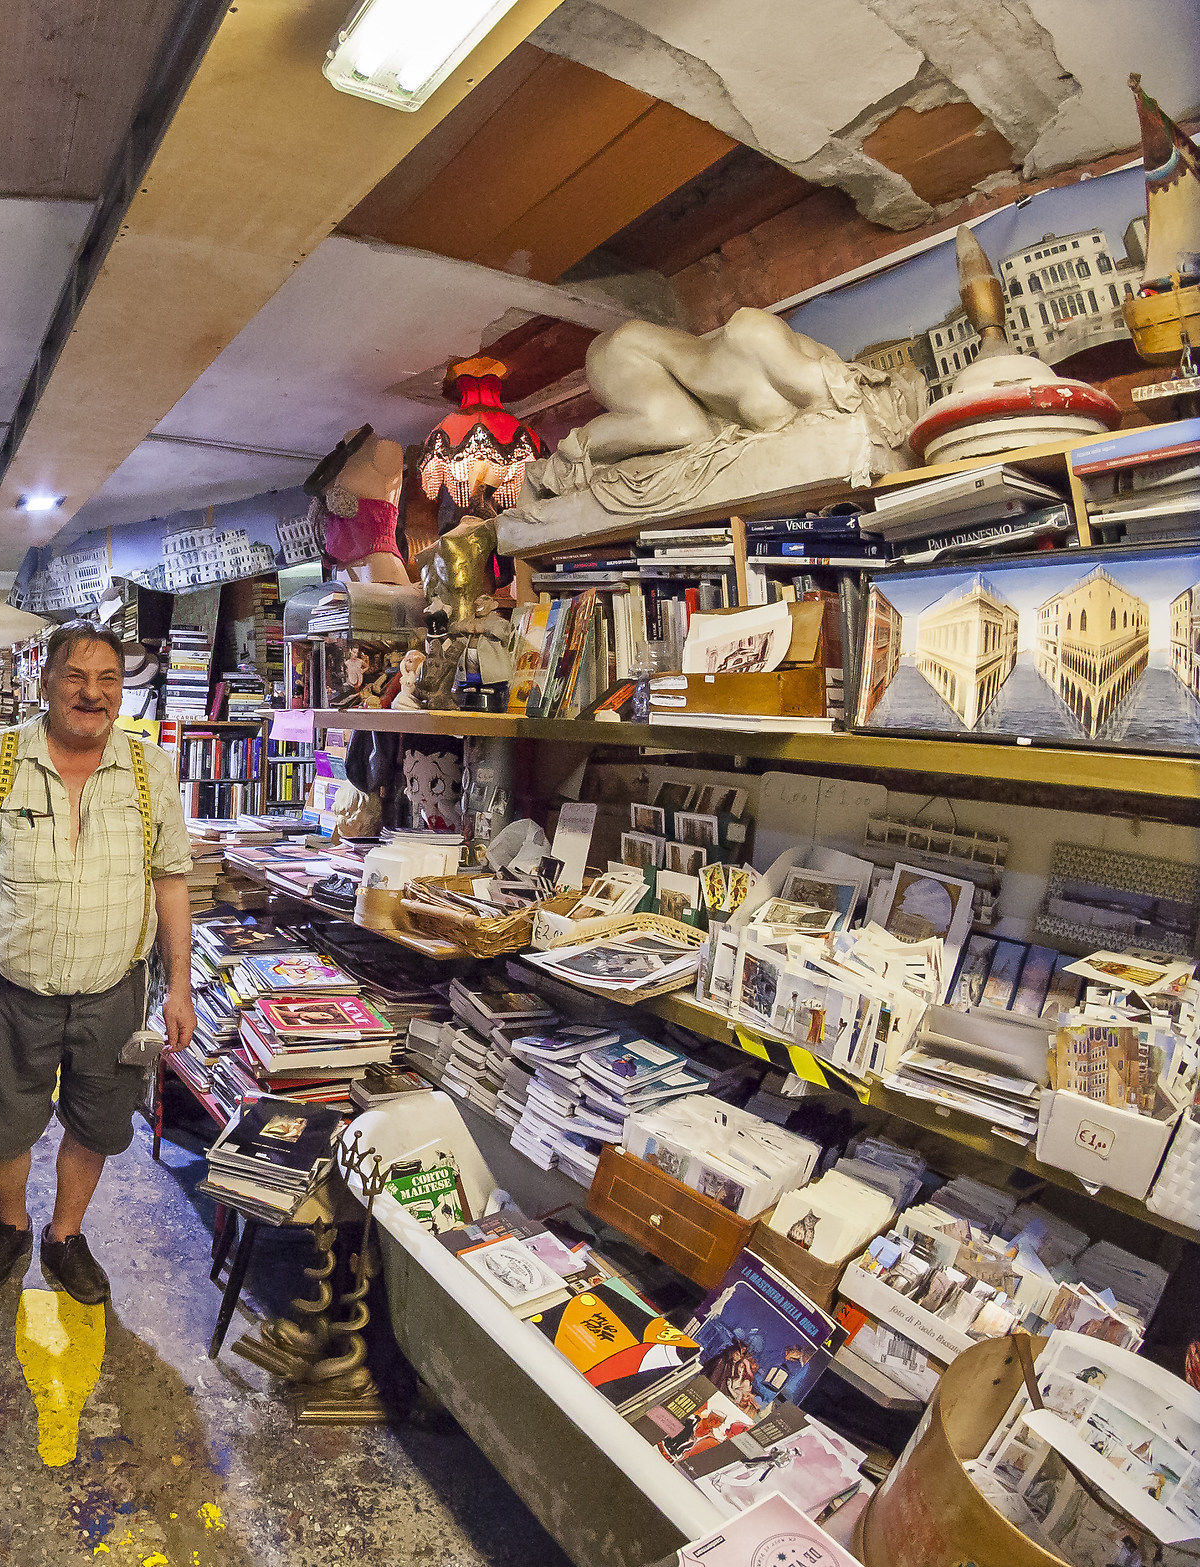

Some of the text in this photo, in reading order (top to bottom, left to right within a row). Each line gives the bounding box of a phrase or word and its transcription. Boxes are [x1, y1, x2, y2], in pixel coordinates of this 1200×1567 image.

[785, 520, 814, 531] VENICE
[927, 524, 1012, 551] PALLADIANESIMO
[411, 1168, 449, 1187] CORTO
[400, 1178, 453, 1200] MALTESE
[740, 1266, 752, 1278] LA
[889, 1305, 905, 1318] foto
[905, 1314, 914, 1323] di
[914, 1317, 936, 1338] Paolo
[803, 1547, 823, 1565] DE
